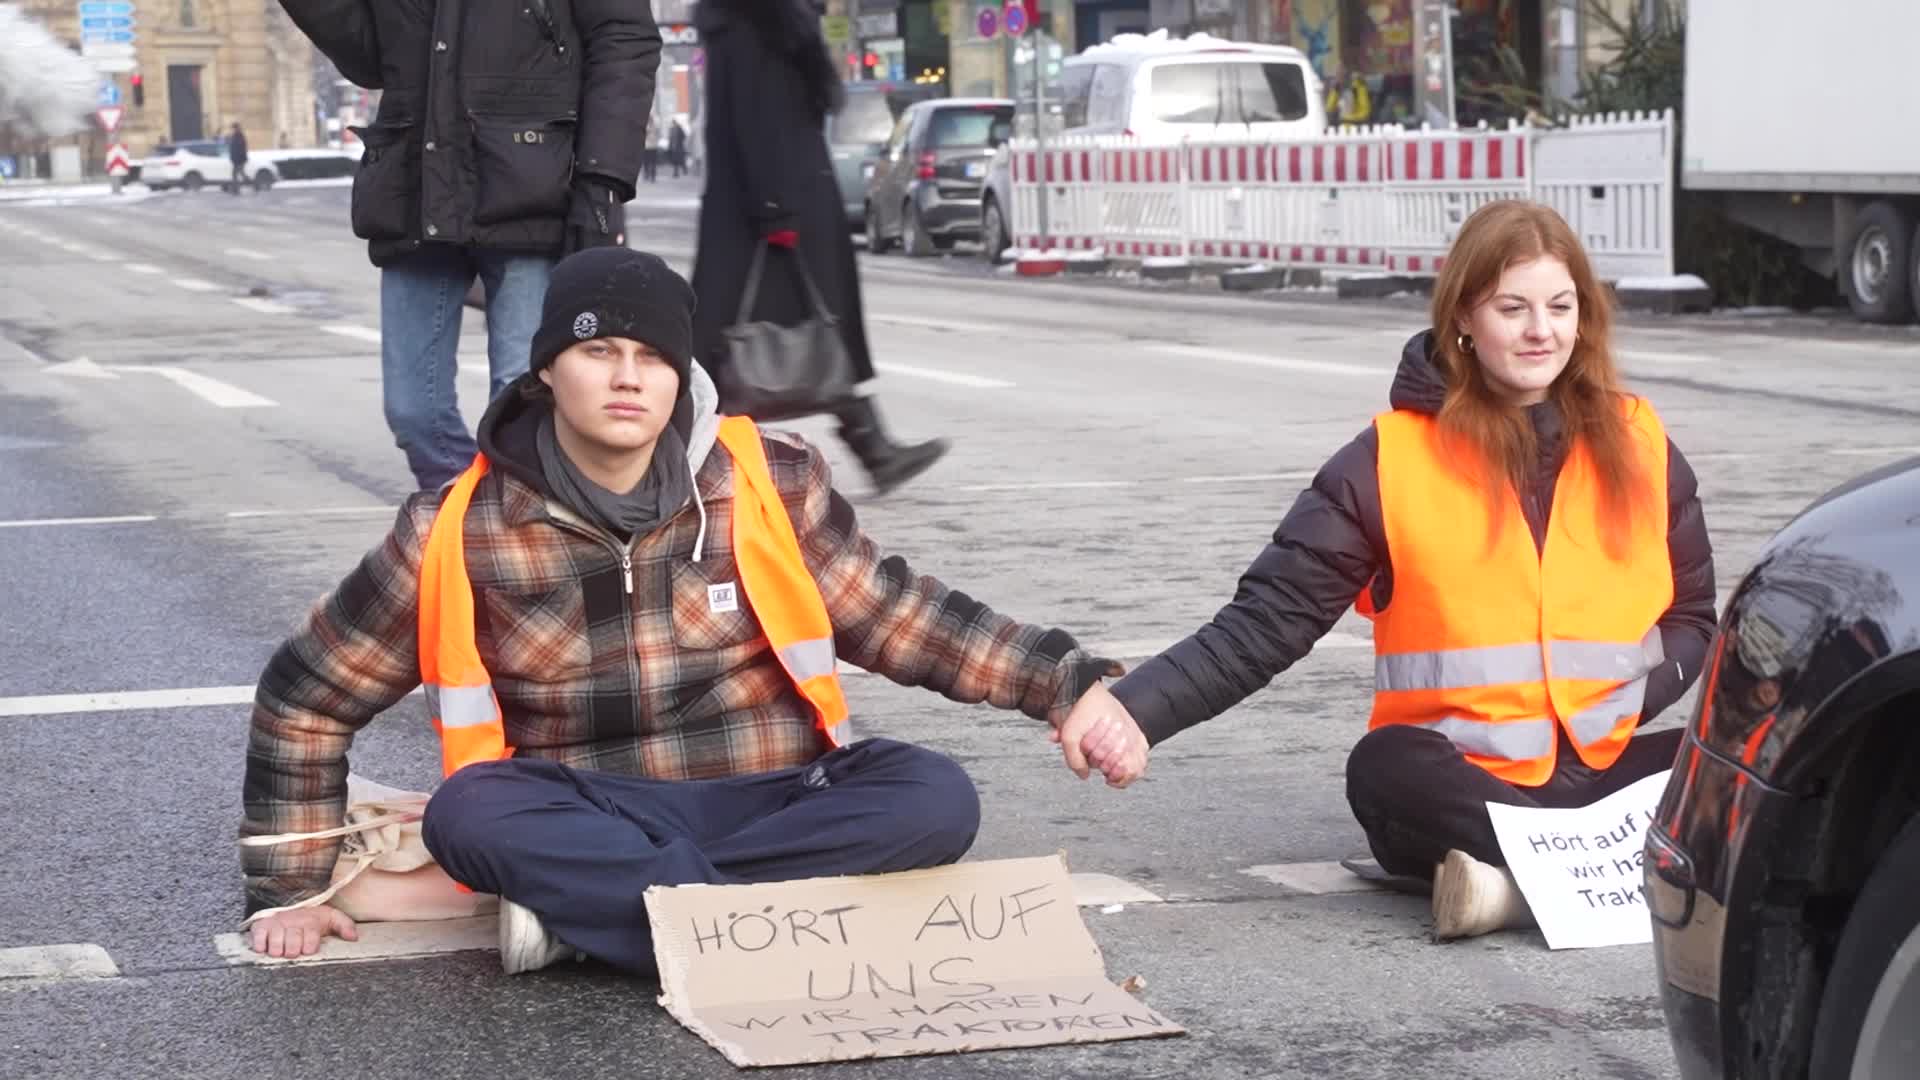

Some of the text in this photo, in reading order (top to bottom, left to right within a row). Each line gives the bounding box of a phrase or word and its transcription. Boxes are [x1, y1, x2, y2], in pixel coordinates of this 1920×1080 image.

[1527, 831, 1589, 854] Hört
[1594, 812, 1637, 849] auf
[1567, 861, 1605, 879] wir
[689, 883, 1057, 954] HÖRT AUF
[807, 956, 996, 1002] UNS
[722, 990, 1095, 1030] WIR HABEN
[807, 1011, 1164, 1043] TRAKTOREN
